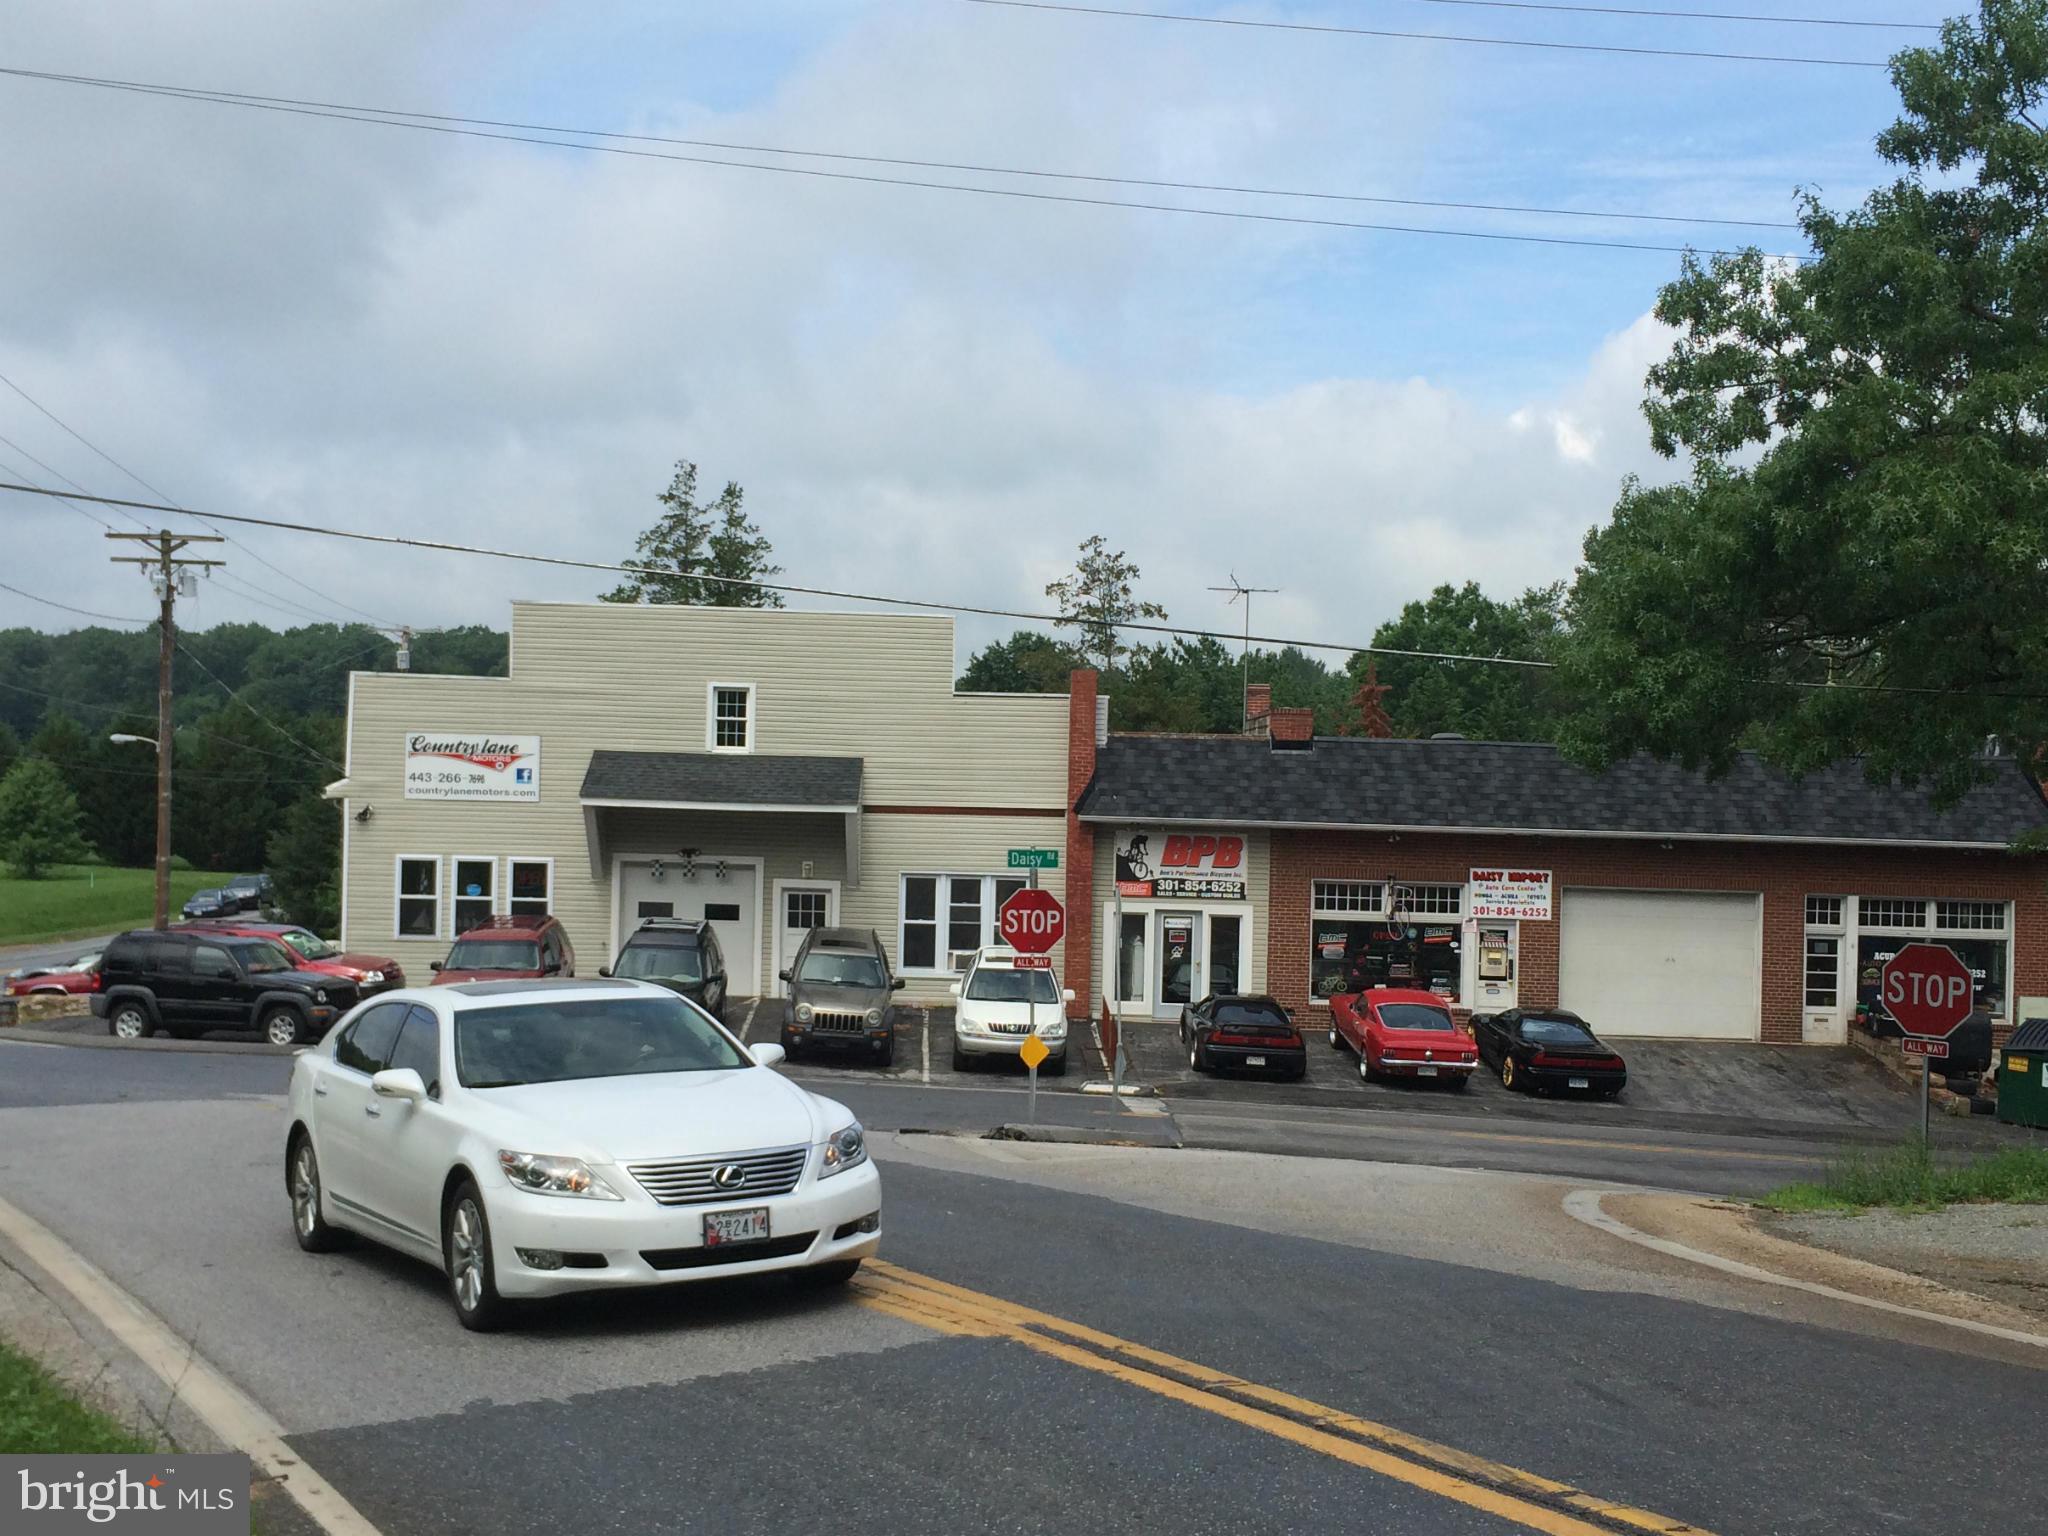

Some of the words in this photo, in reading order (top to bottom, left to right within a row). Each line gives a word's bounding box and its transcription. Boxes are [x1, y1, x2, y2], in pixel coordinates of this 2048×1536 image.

[408, 786, 536, 797] countrylanemotors.com
[1159, 834, 1244, 868] BPB
[1011, 851, 1042, 867] Daisy
[1472, 871, 1504, 882] DAISY
[1508, 871, 1550, 883] IMPORT
[1157, 879, 1241, 893] 301-854-6252
[1472, 905, 1549, 918] 301-854-6252
[1004, 908, 1061, 935] STOP
[1016, 958, 1031, 967] ALL
[1033, 958, 1049, 967] WAY
[1887, 970, 1967, 1009] STOP
[1907, 1042, 1923, 1053] ALL
[1926, 1044, 1944, 1055] WAY
